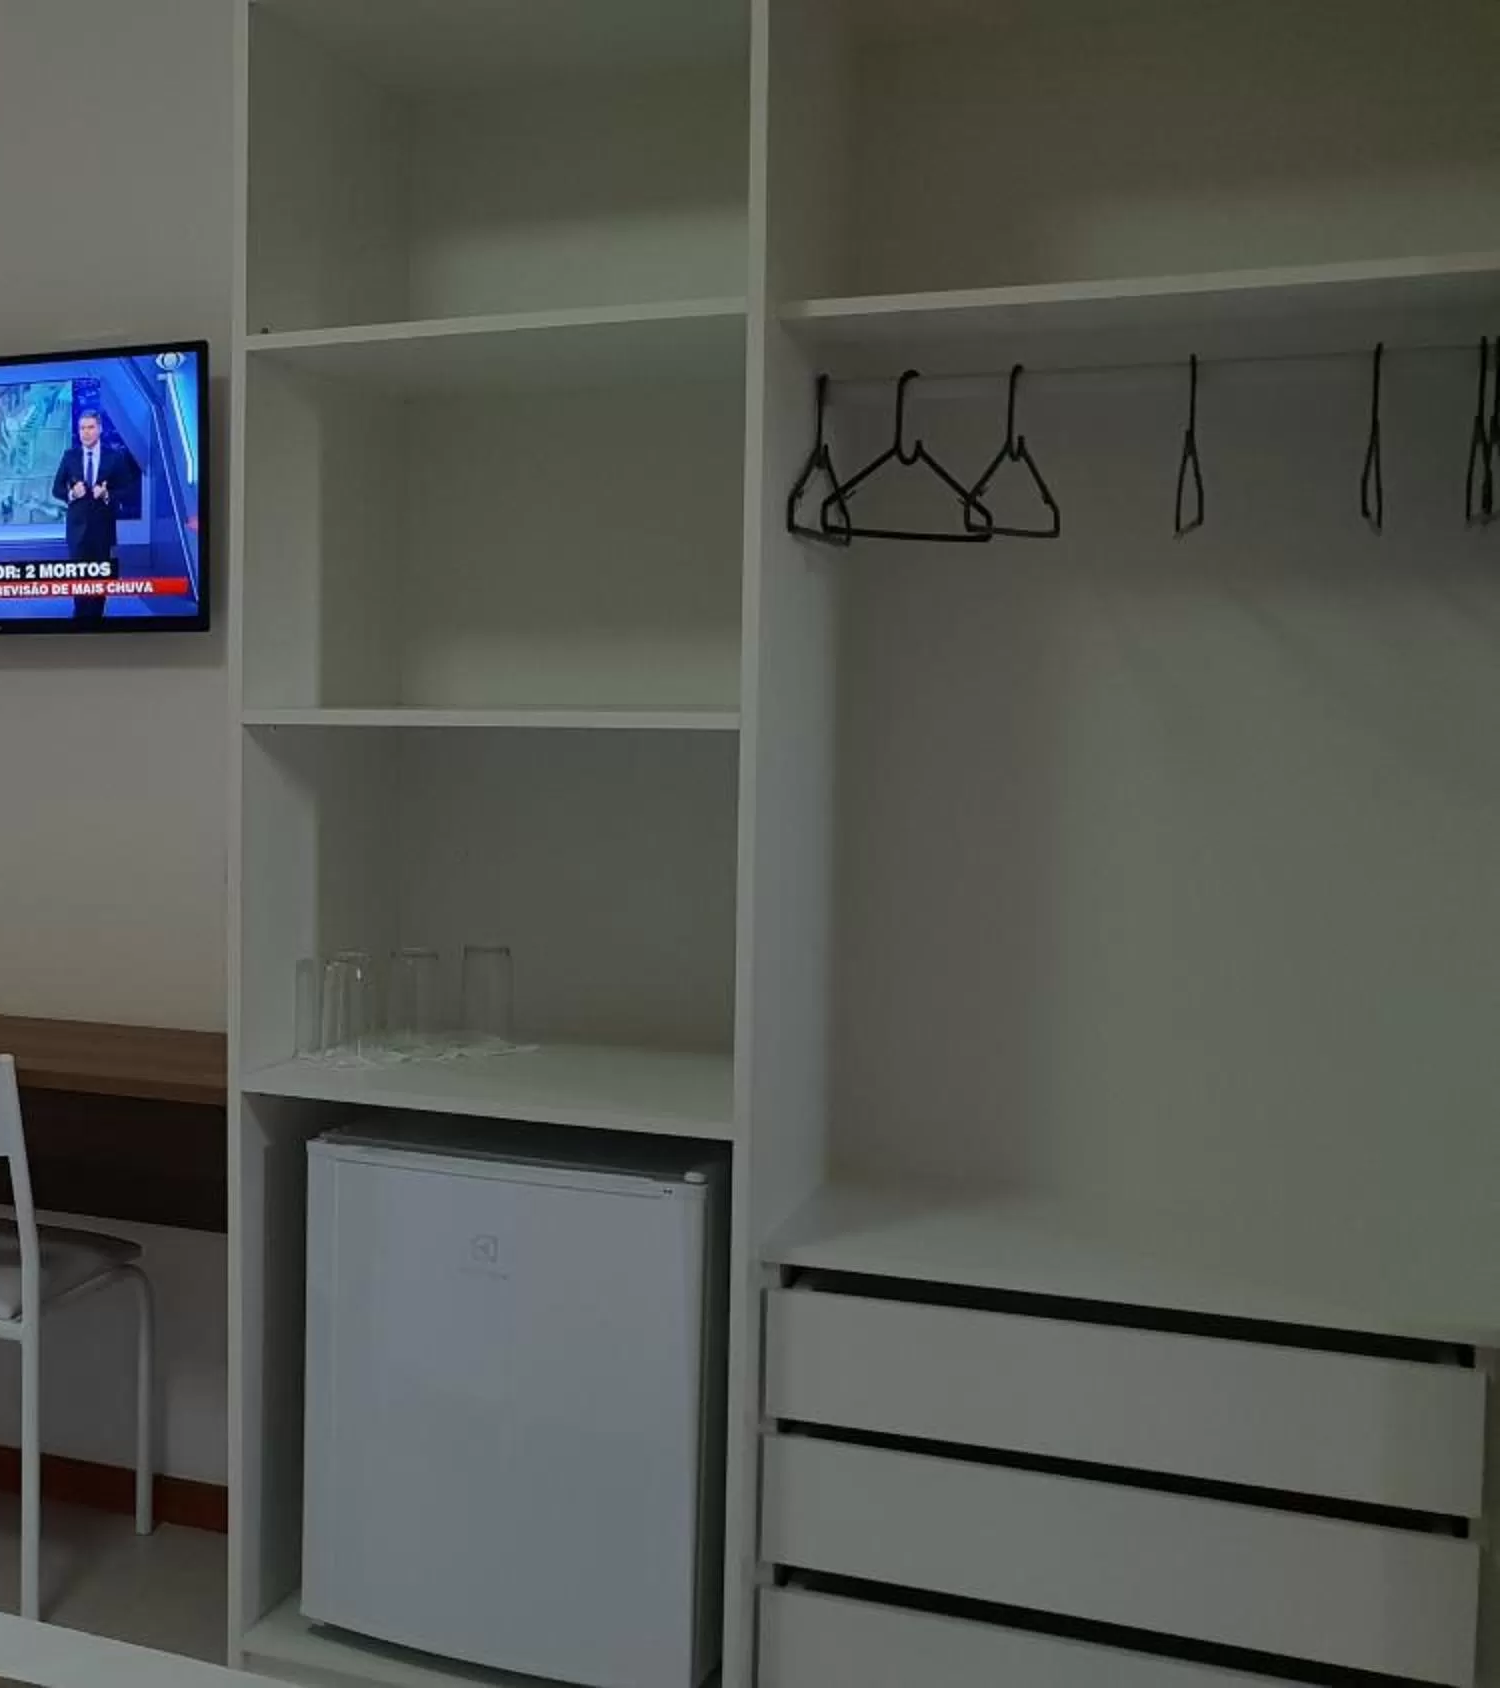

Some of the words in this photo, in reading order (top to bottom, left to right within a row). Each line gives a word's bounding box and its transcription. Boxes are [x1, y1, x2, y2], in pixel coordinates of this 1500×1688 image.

[25, 564, 36, 579] 2
[40, 562, 111, 578] MORTOS
[51, 584, 69, 595] DE
[71, 583, 105, 595] MAIS
[106, 581, 154, 594] CHUVA
